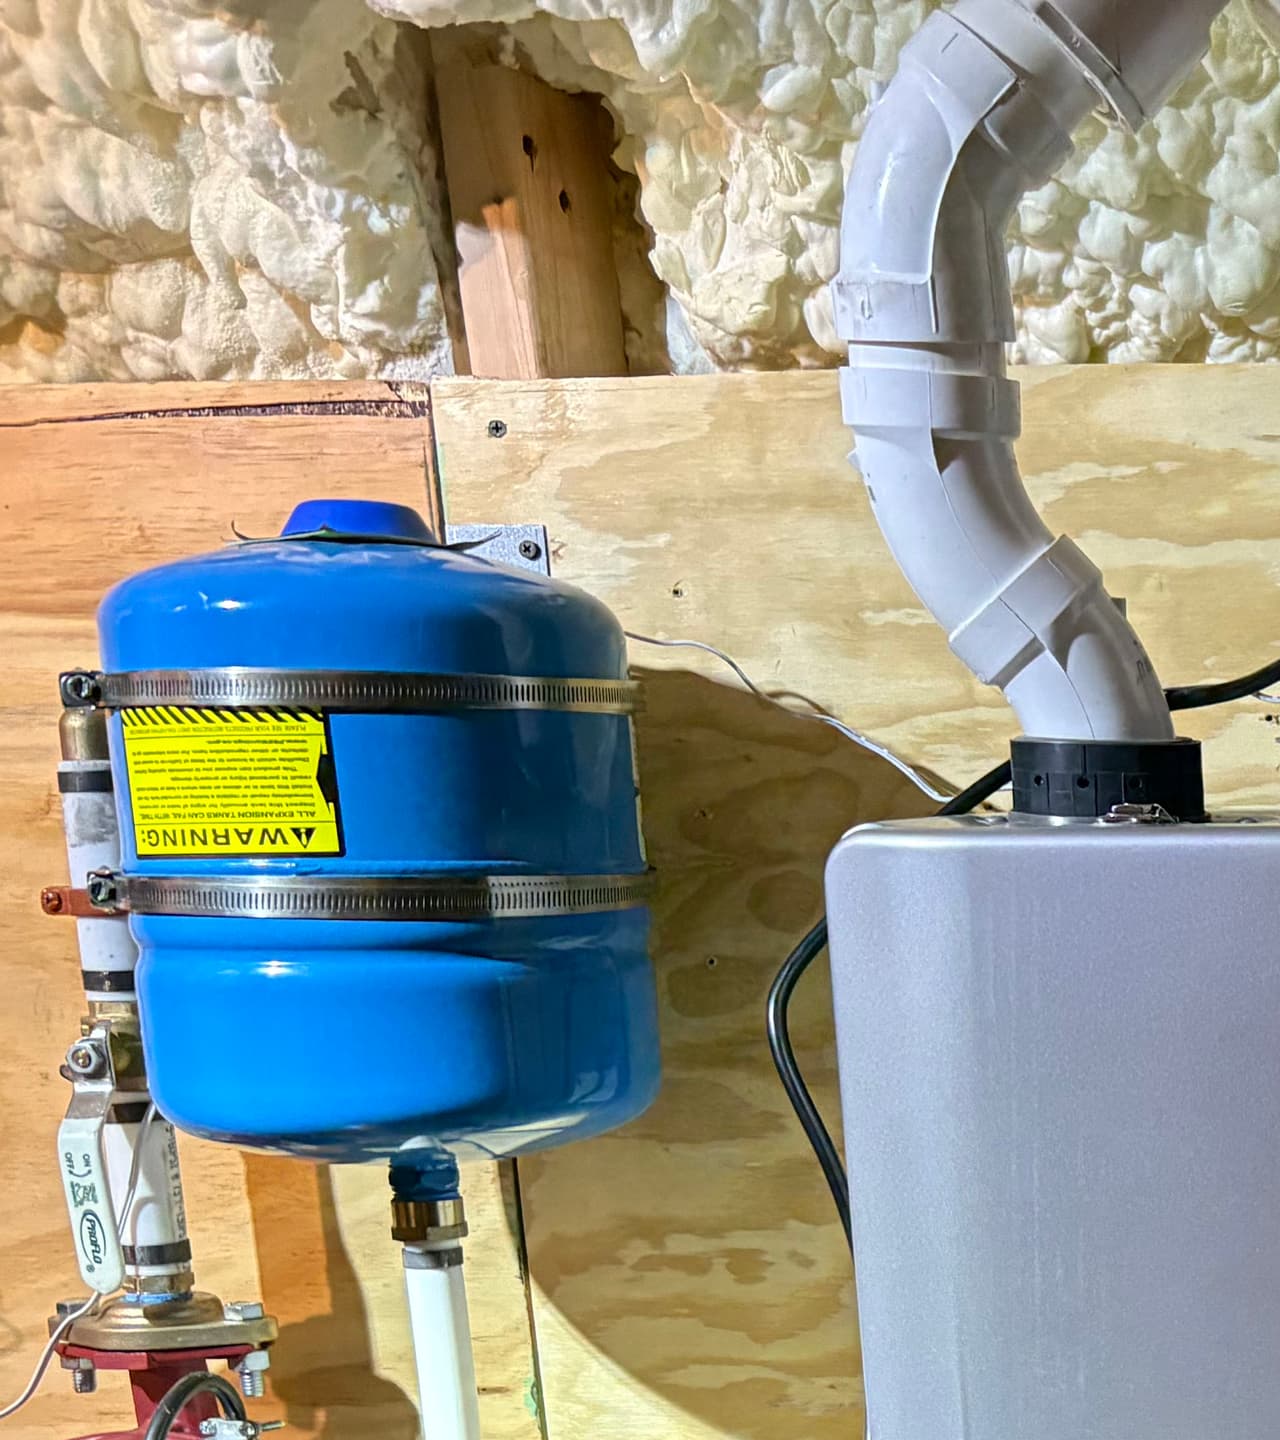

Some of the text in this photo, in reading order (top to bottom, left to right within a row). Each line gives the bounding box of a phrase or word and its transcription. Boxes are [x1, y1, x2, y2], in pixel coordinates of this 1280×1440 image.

[141, 828, 288, 847] WARNING:
[65, 1152, 75, 1169] OFF
[83, 1153, 92, 1167] ON
